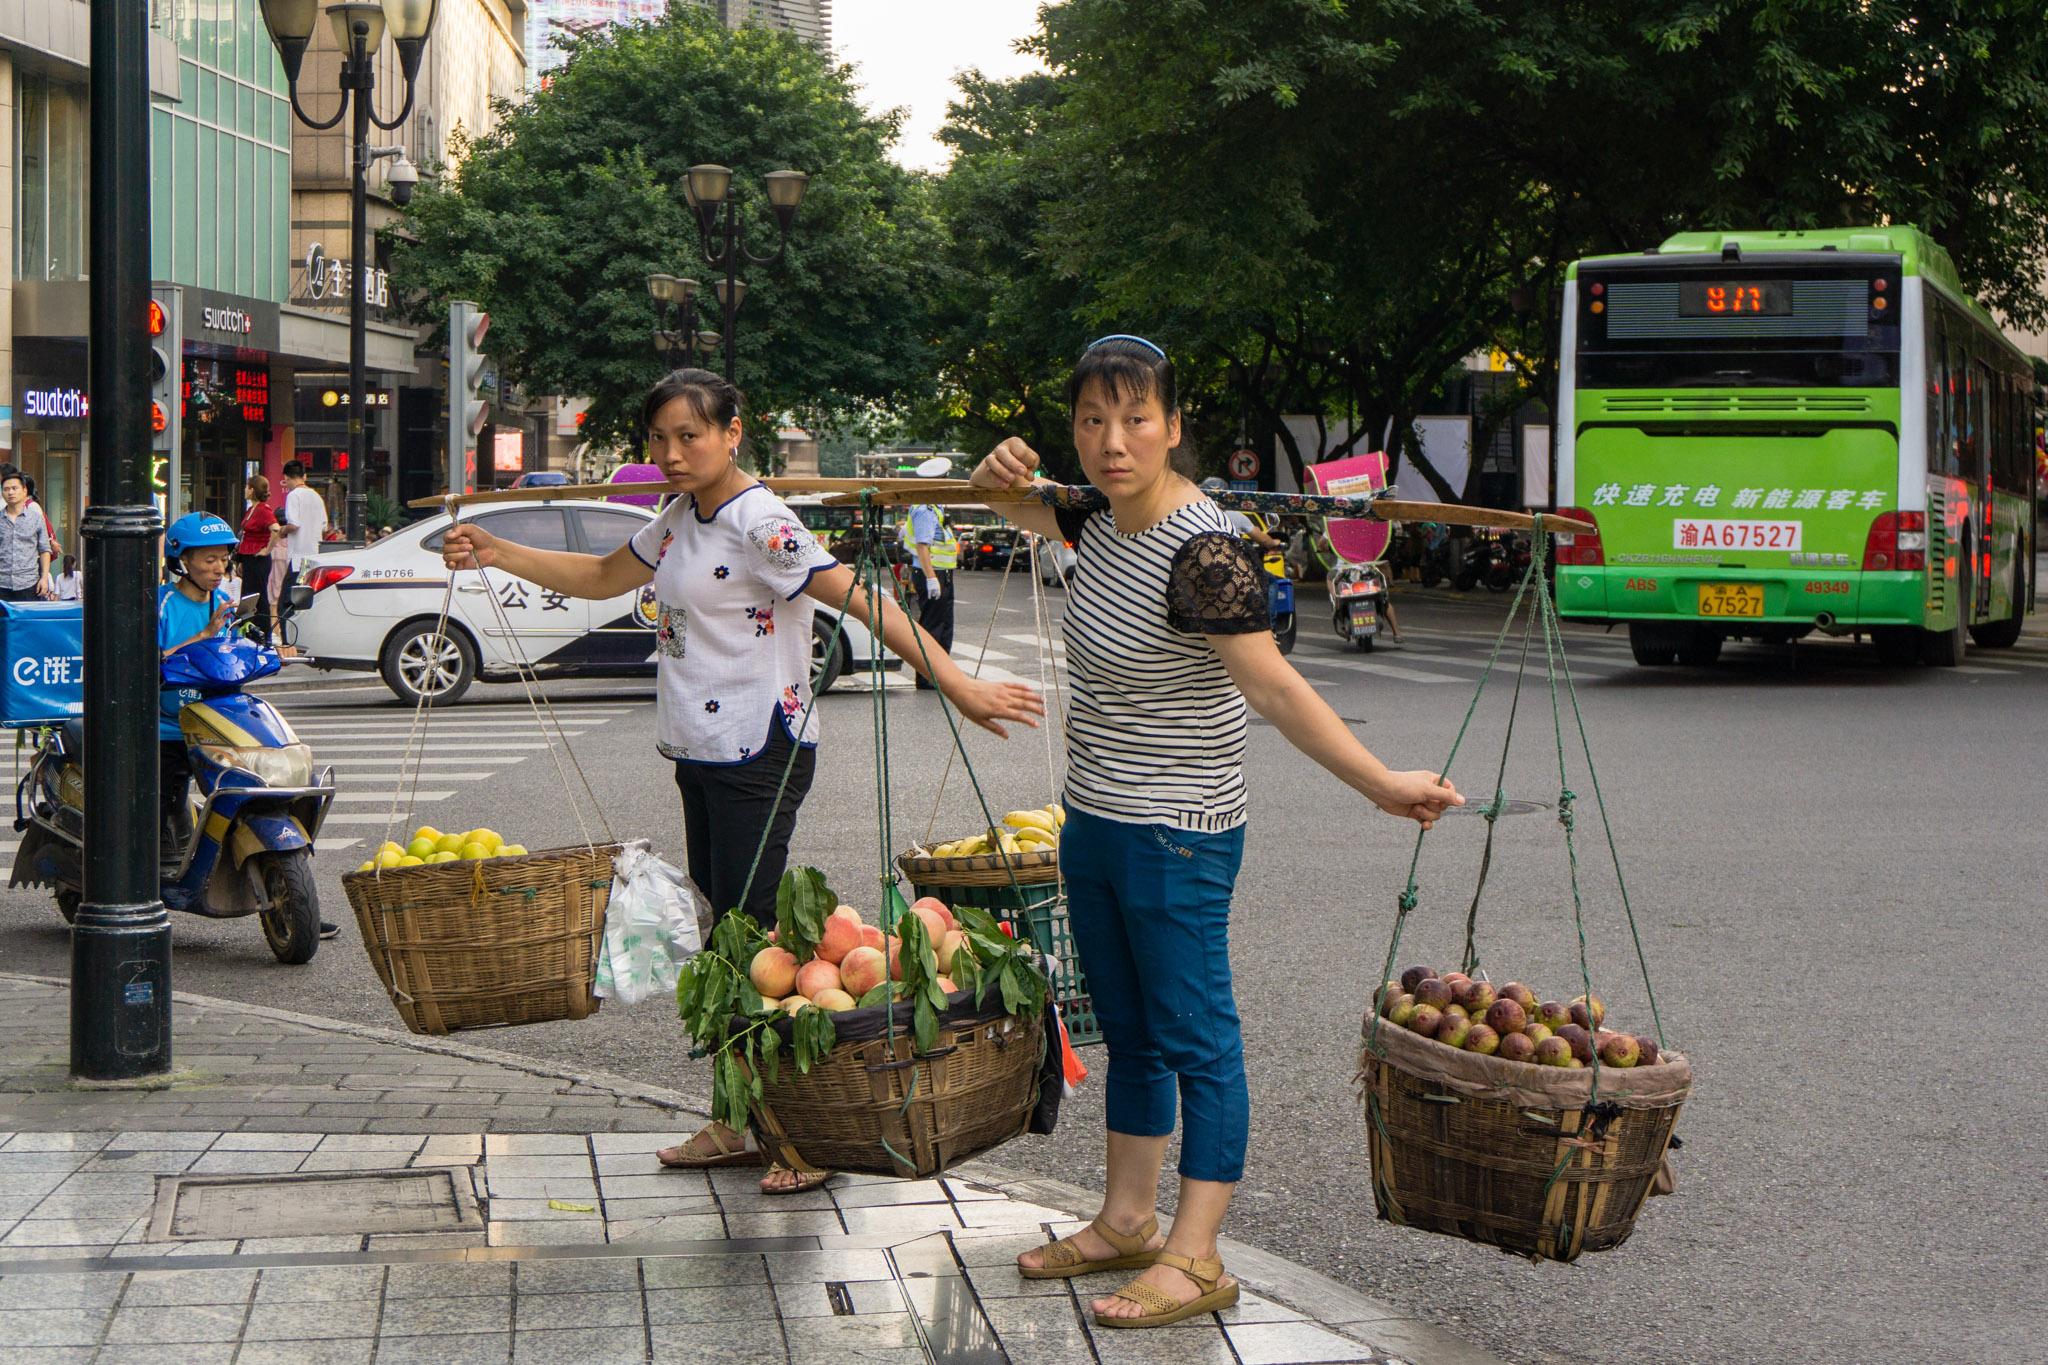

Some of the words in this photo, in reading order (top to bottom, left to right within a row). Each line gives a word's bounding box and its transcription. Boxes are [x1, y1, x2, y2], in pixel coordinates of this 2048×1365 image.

[330, 258, 389, 308] 全酒店
[340, 393, 390, 405] 全酒店
[1591, 482, 1721, 507] 快速充电
[1730, 488, 1888, 511] 新能源客车
[1679, 522, 1797, 548] 渝A67527
[1625, 577, 1658, 592] ABS
[1804, 581, 1850, 595] 49349
[1702, 596, 1761, 616] 67527
